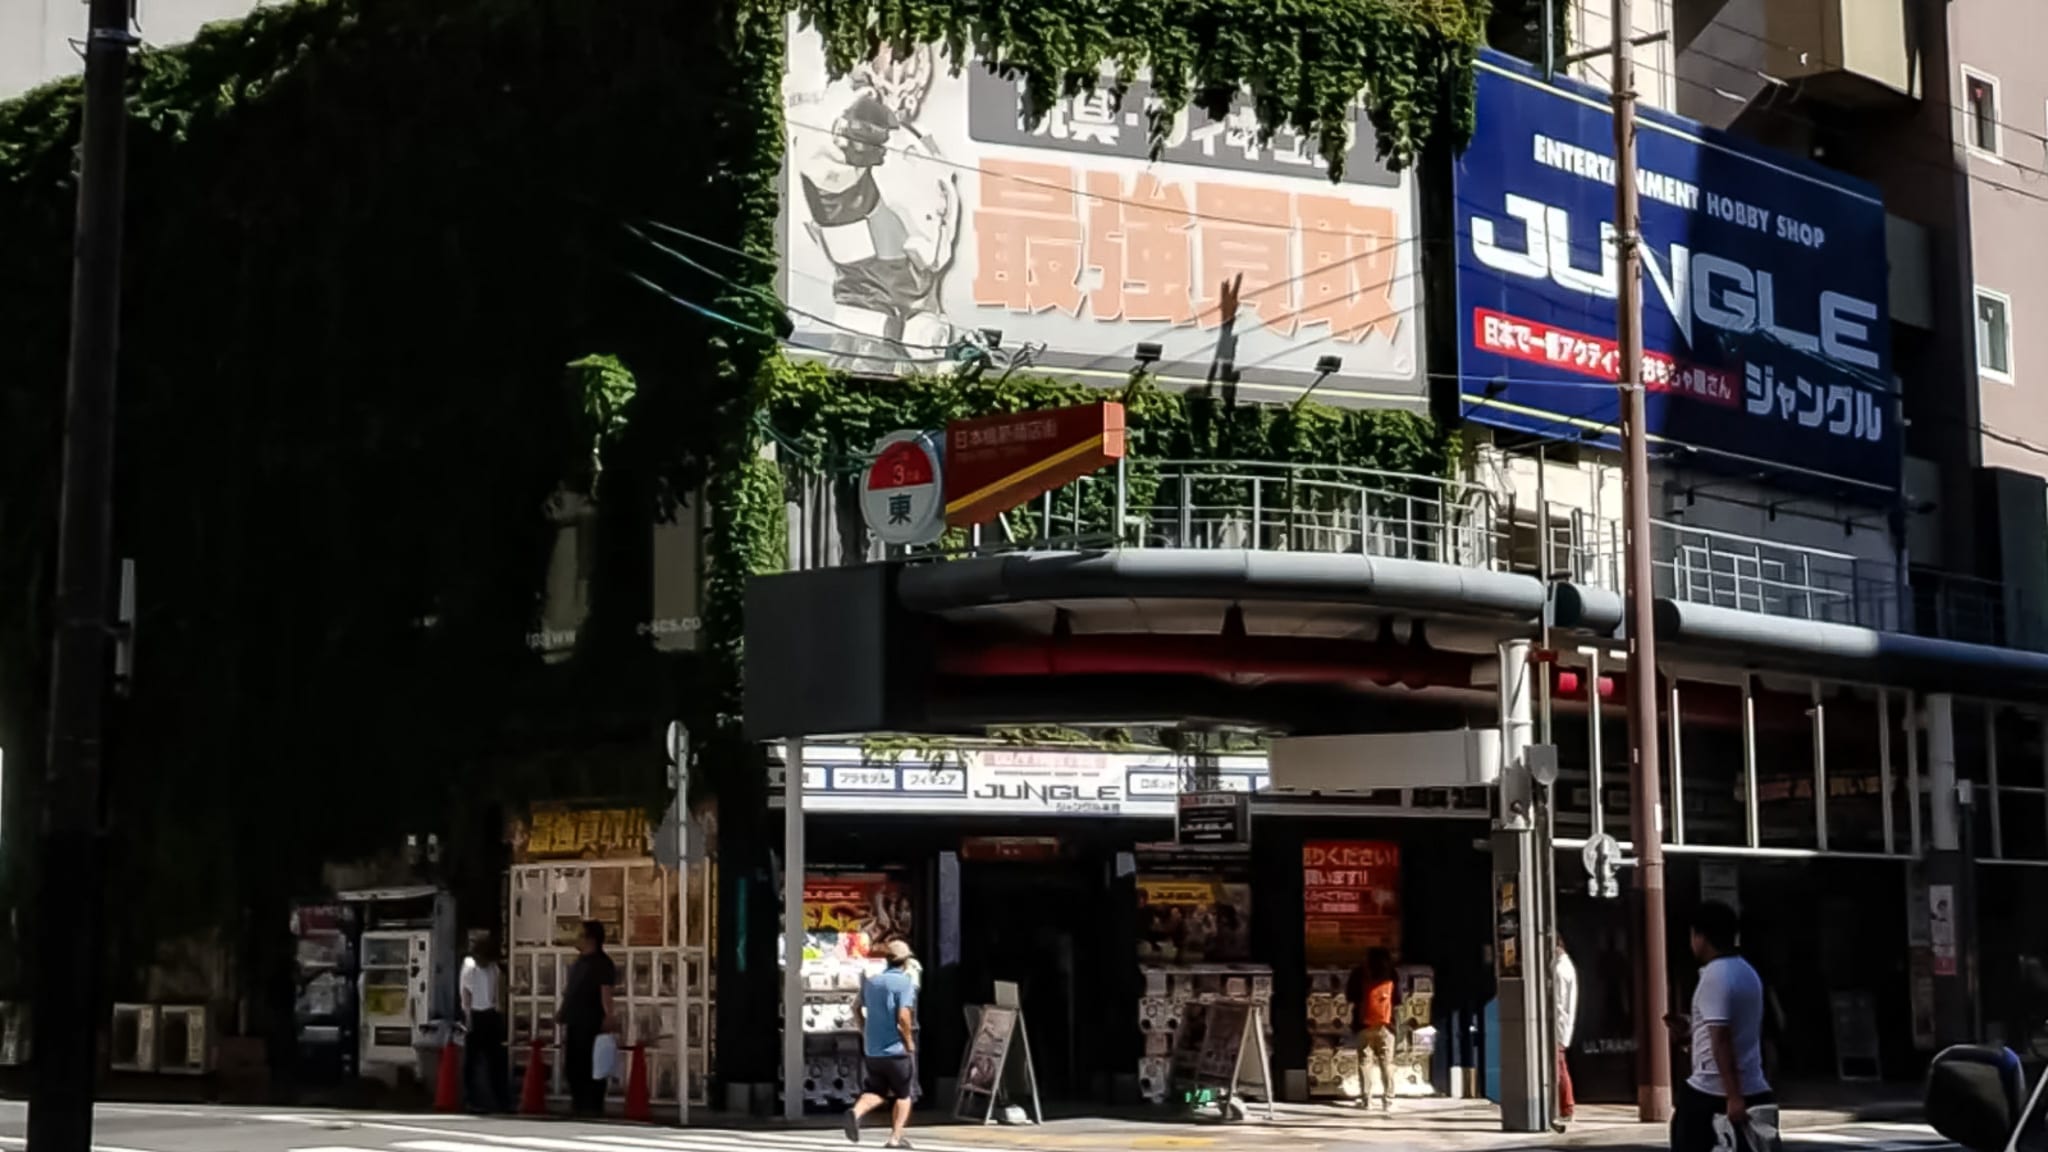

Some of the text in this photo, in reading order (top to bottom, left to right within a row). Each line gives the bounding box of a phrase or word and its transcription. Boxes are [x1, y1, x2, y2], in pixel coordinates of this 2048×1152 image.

[1534, 134, 1825, 248] ENTERTANMENT HOBBY SHOP
[972, 157, 1401, 344] 最強買取
[1472, 193, 1879, 369] JUNGLE
[1484, 316, 1732, 399] 日本で一番アクティおもちゃ屋さん
[1745, 361, 1881, 441] ジャングル
[888, 492, 912, 524] 東
[839, 772, 890, 785] プラモデル
[909, 773, 957, 786] フィギュア
[973, 780, 1121, 805] JUNGLE
